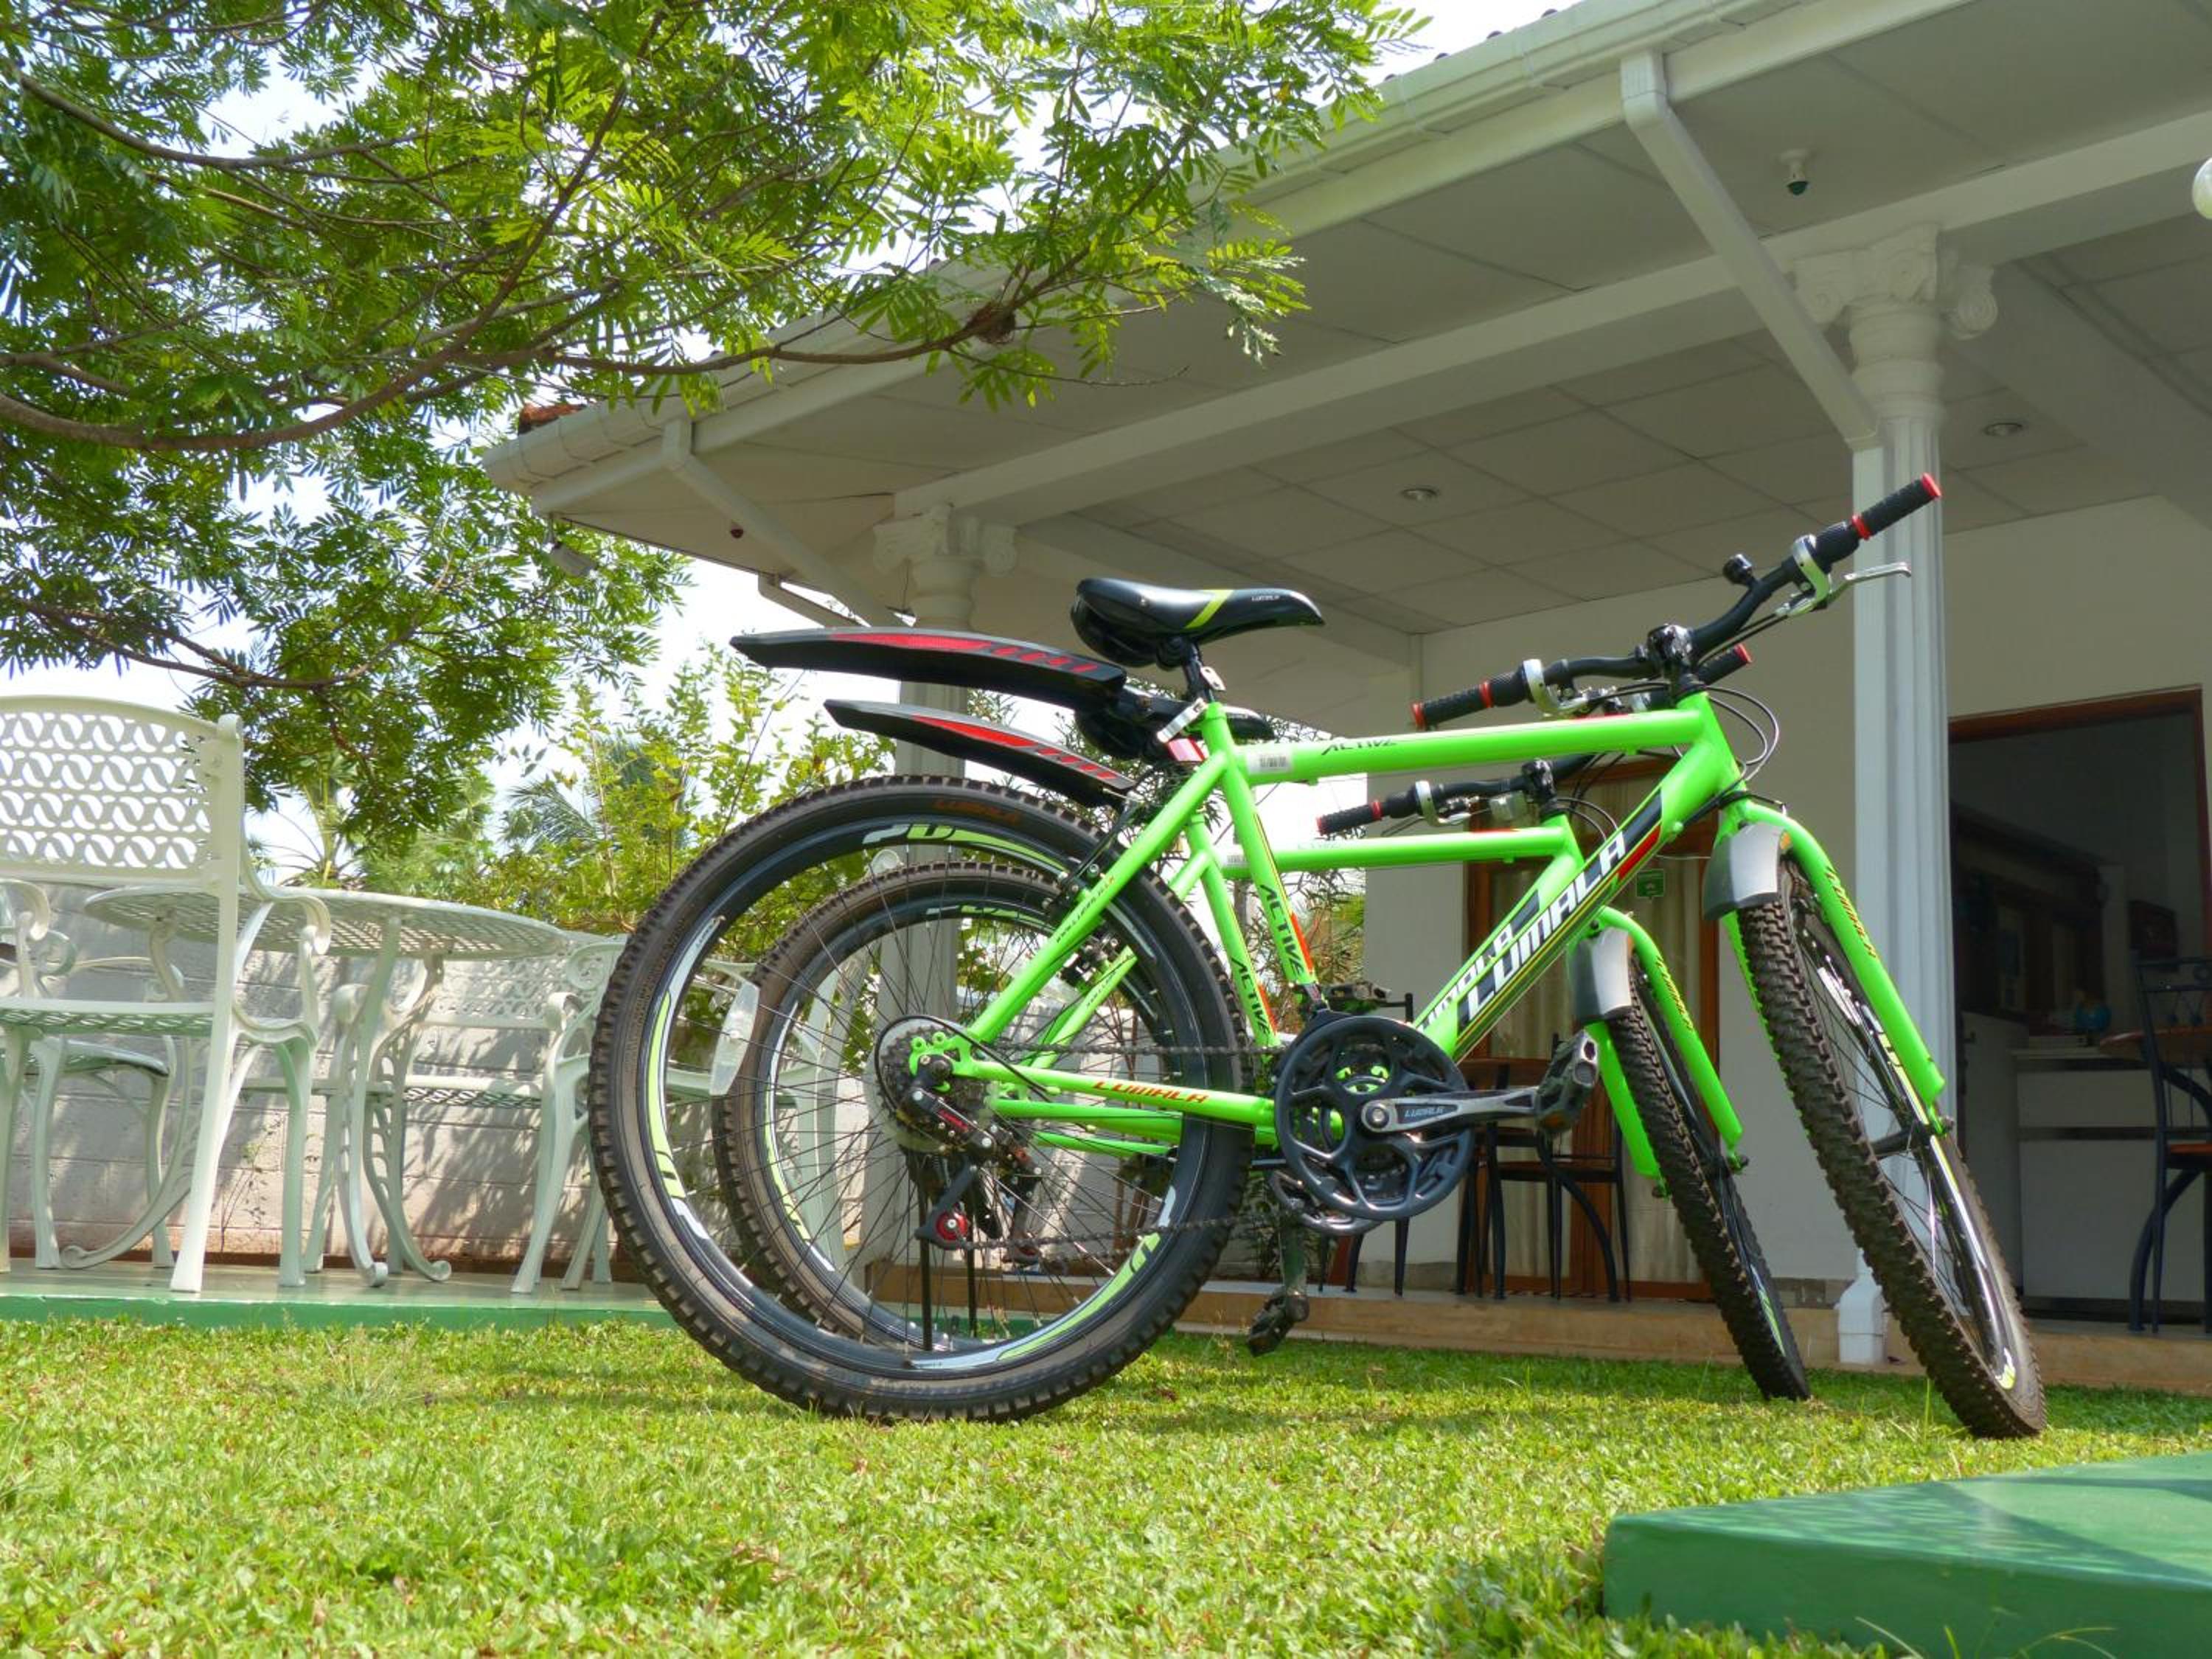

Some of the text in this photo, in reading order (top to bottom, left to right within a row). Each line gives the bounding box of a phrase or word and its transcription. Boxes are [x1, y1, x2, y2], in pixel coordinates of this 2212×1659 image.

[1321, 738, 1398, 755] ACTIVE
[1259, 884, 1305, 978] ACTIVE
[1469, 830, 1626, 1022] LUMALA
[1231, 957, 1270, 1034] ACTIVE
[1092, 1082, 1209, 1104] LUMALA
